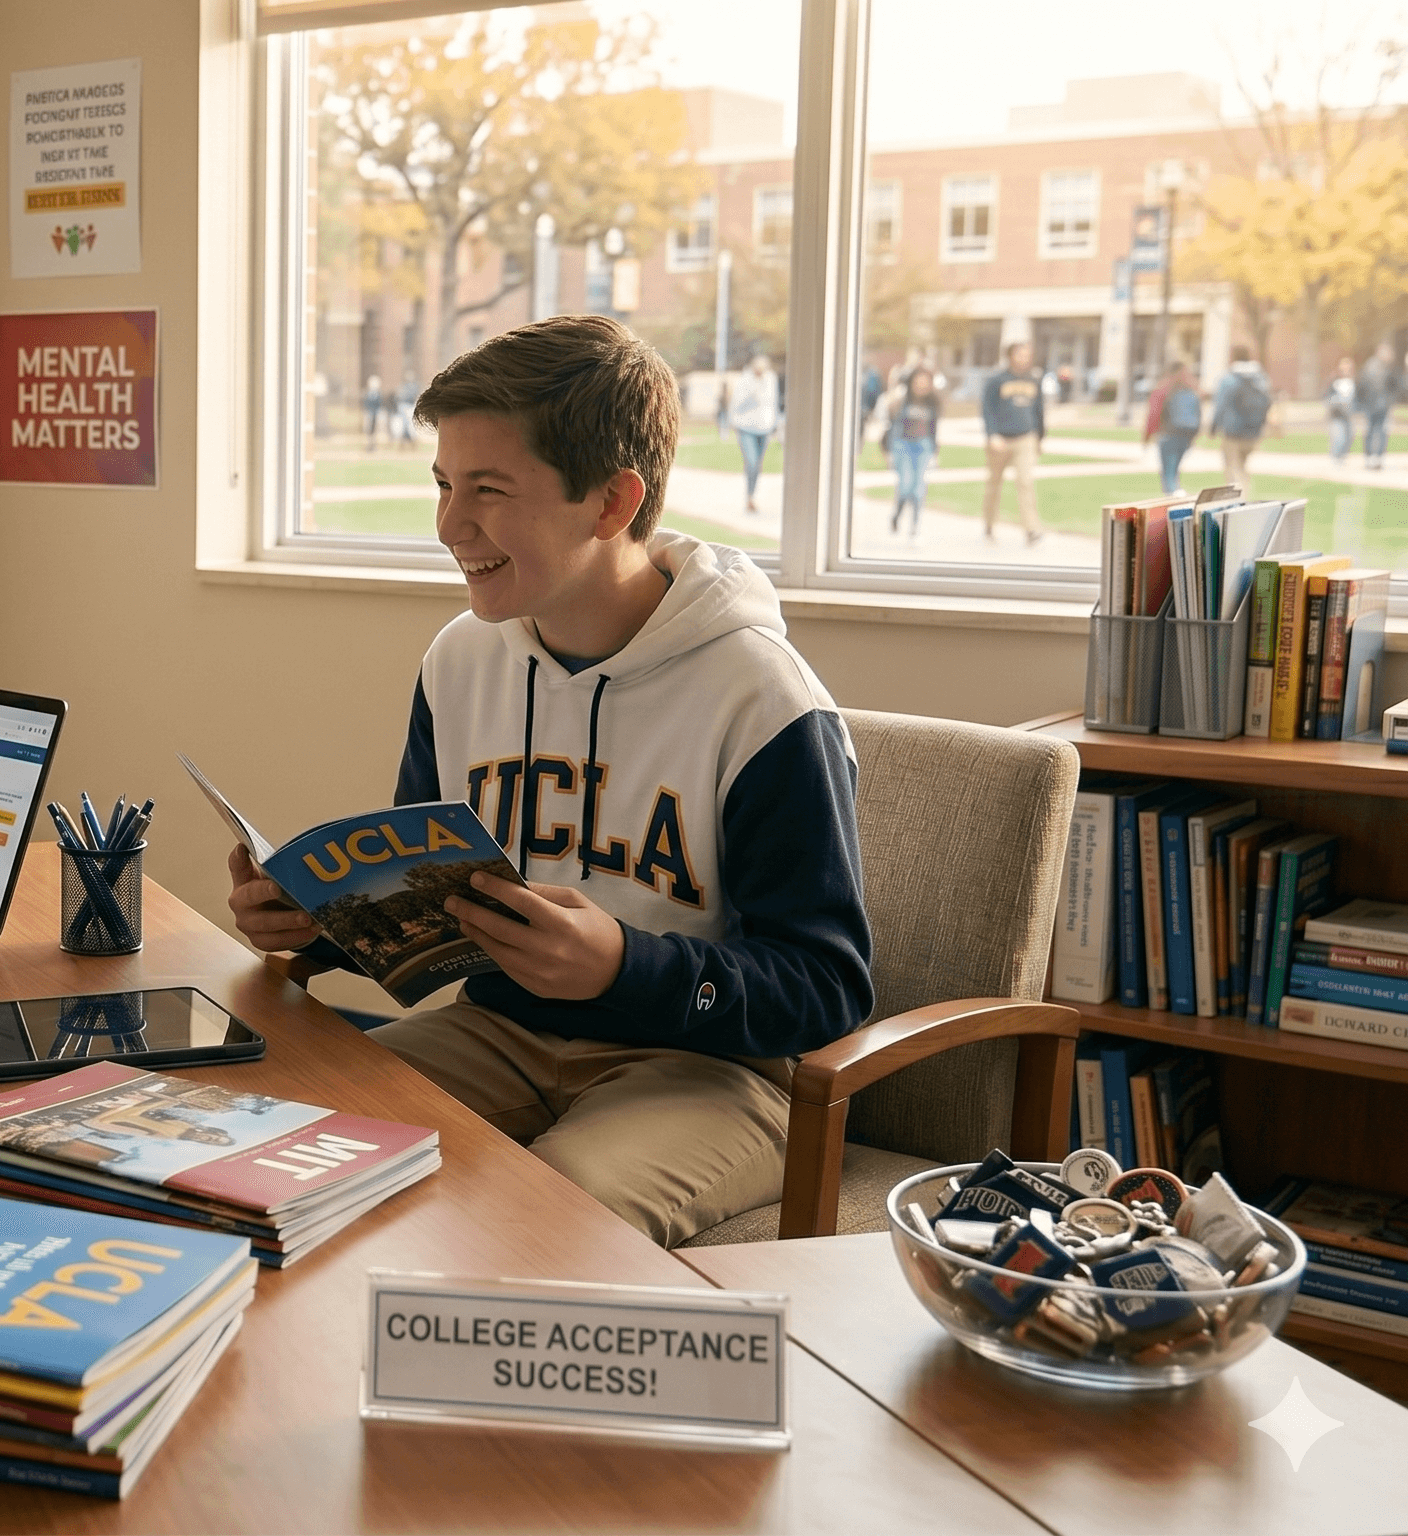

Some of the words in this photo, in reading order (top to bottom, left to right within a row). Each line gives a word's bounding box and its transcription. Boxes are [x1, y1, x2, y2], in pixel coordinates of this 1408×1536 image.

[18, 346, 135, 378] MENTAL
[18, 382, 133, 415] HEALTH
[11, 418, 140, 450] MATTERS
[302, 816, 474, 884] UCLA
[467, 753, 705, 910] UCLA
[253, 1132, 381, 1182] MIT
[386, 1312, 537, 1349] COLLEGE
[546, 1322, 769, 1364] ACCEPTANCE
[493, 1358, 657, 1397] SUCCESS!
